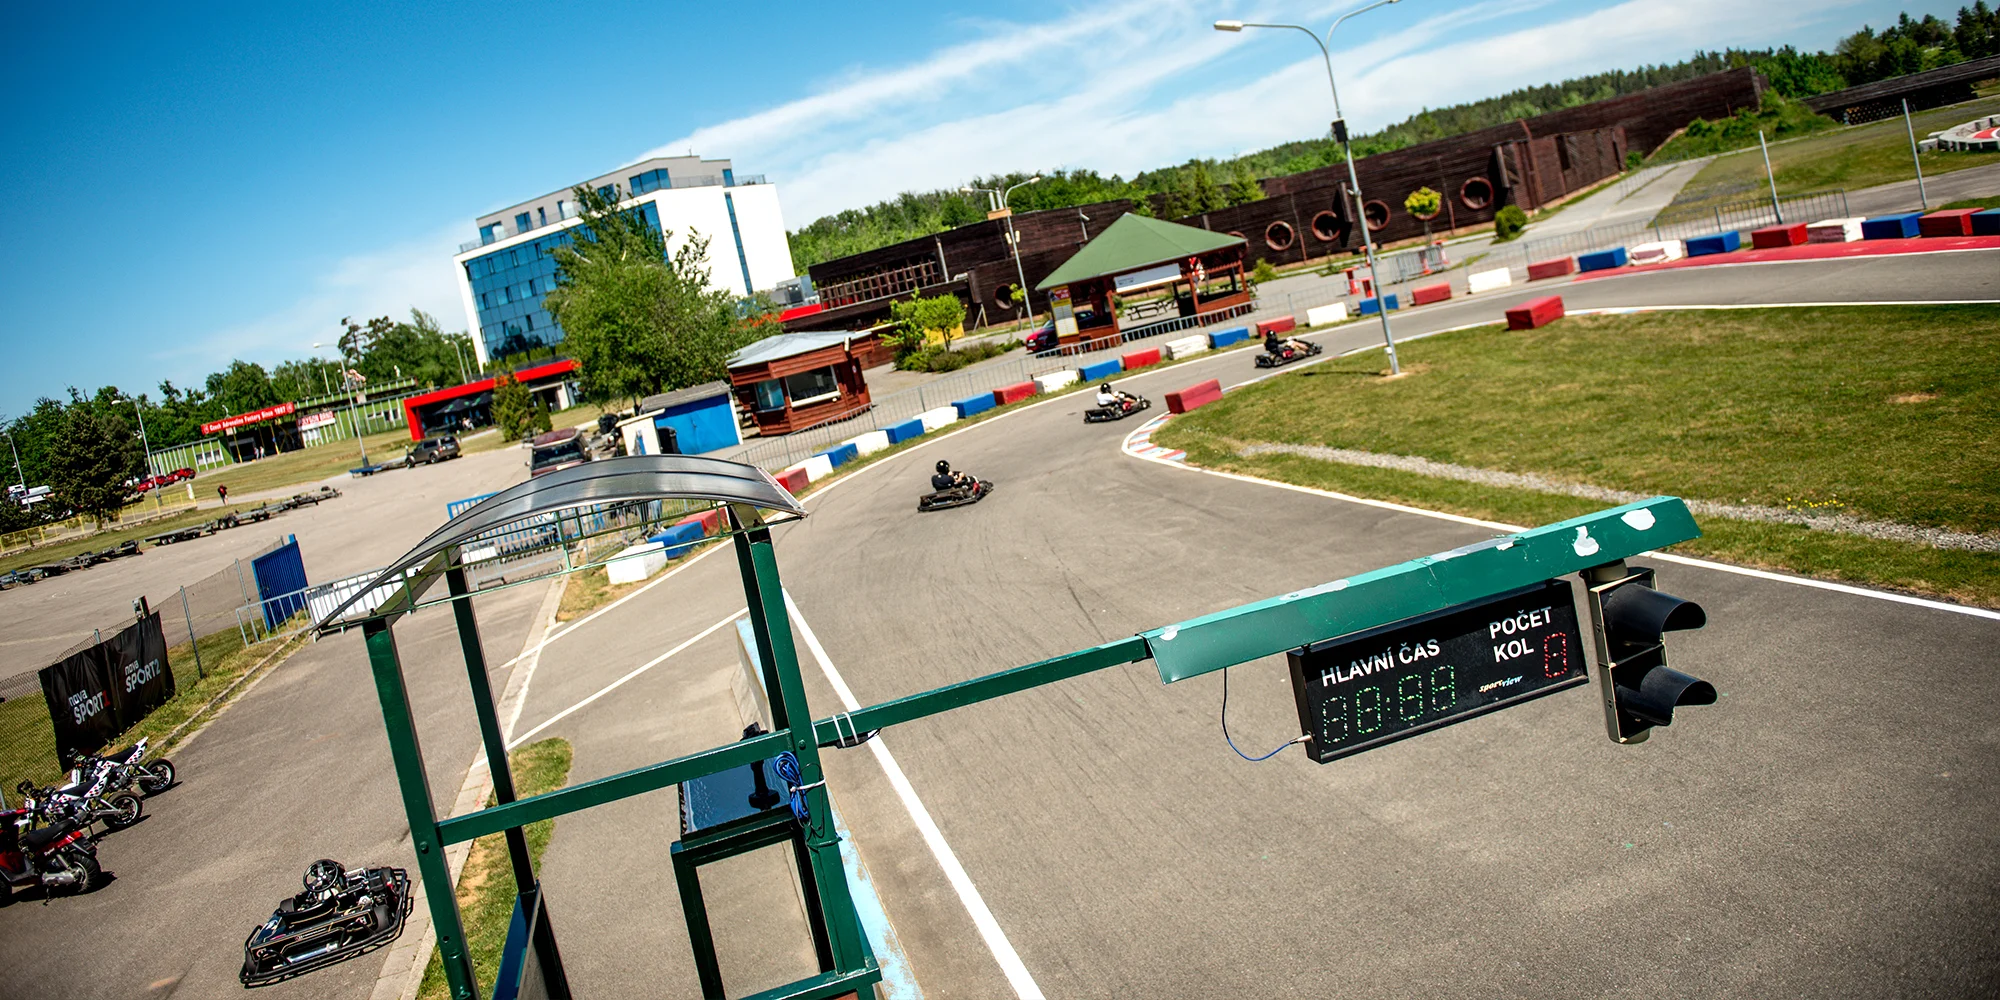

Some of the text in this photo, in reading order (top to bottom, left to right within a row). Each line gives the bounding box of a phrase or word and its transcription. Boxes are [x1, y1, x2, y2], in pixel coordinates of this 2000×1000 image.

[1489, 606, 1552, 639] POČET
[1321, 638, 1441, 687] HLAVNÍ ČAS
[1493, 637, 1534, 662] KOL
[125, 660, 139, 676] nova
[125, 658, 161, 693] SPORT2
[68, 689, 87, 707] nova
[73, 690, 111, 725] SPORT1
